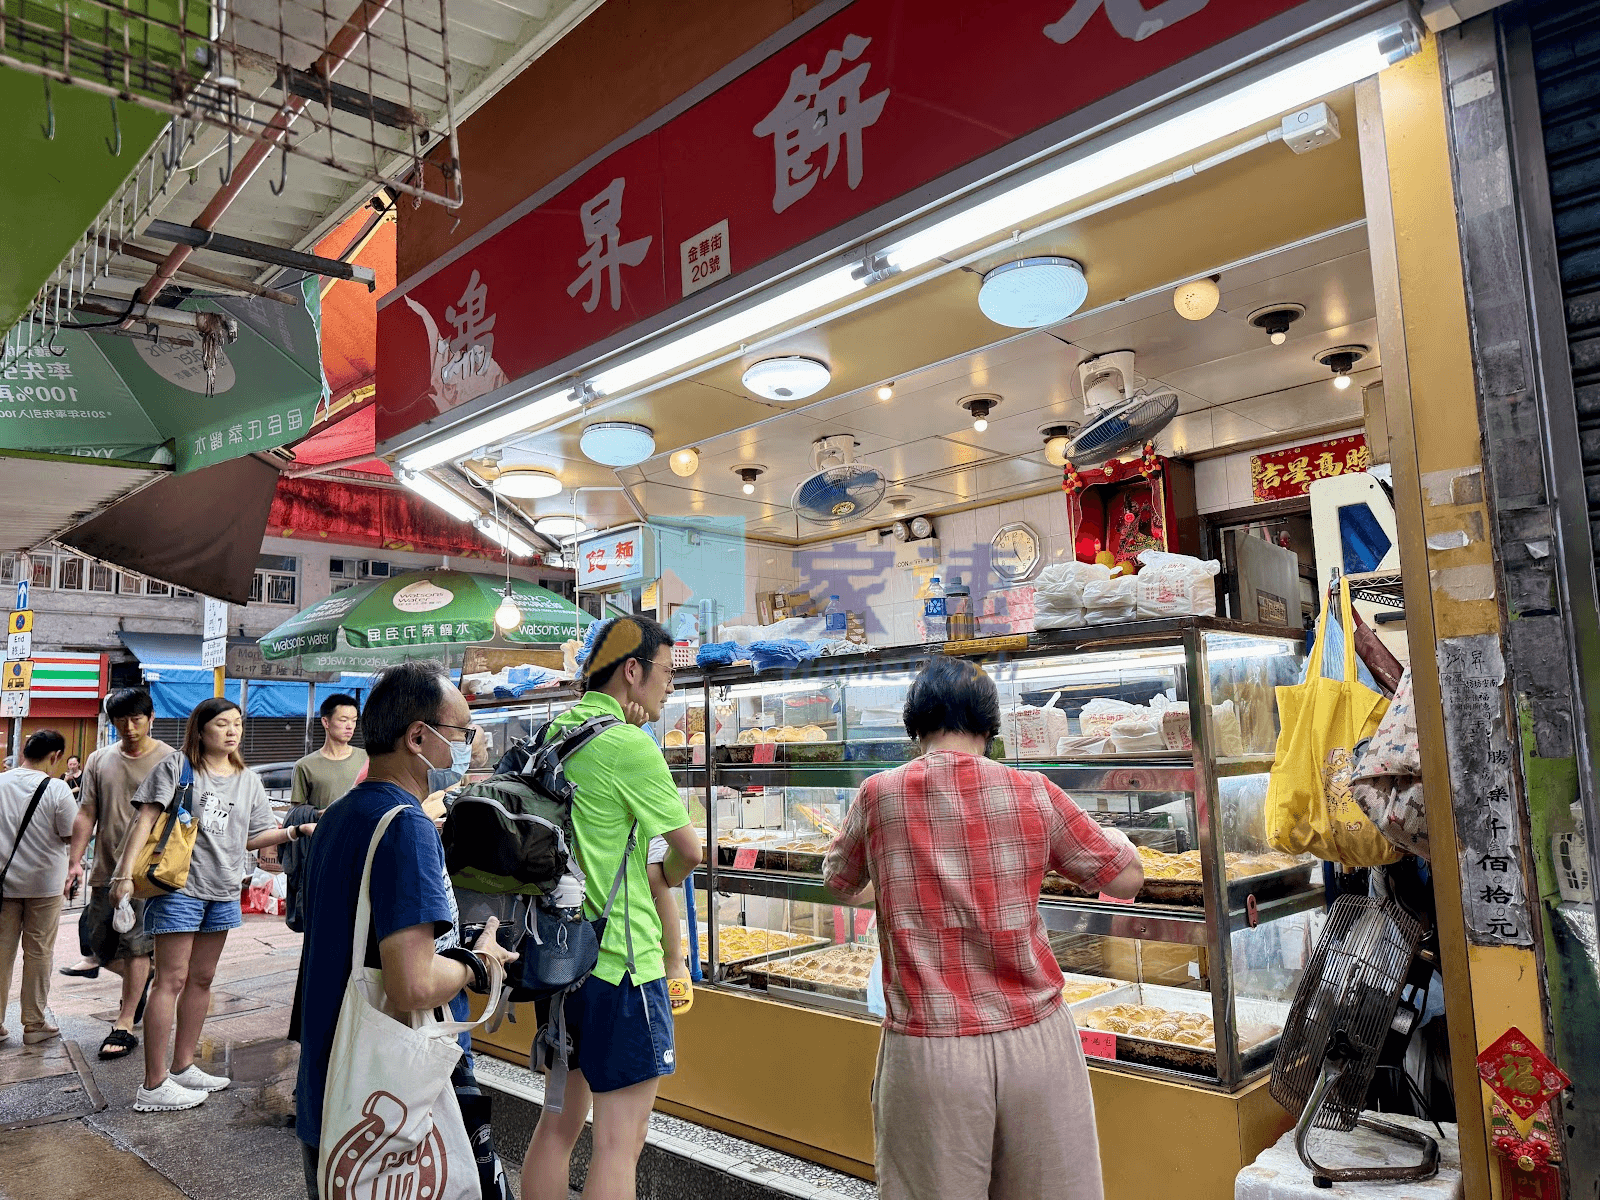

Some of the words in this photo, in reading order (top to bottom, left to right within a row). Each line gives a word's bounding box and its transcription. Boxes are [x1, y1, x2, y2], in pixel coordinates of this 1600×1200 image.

[688, 232, 722, 264] 金華街
[691, 254, 721, 283] 20號
[367, 622, 470, 642] 屈臣氏蒸餾水
[518, 623, 560, 635] watsons
[14, 635, 25, 644] End
[271, 635, 306, 653] watsons
[306, 632, 330, 646] water
[18, 692, 25, 702] 7
[18, 706, 24, 716] 7
[1498, 1053, 1542, 1096] 福
